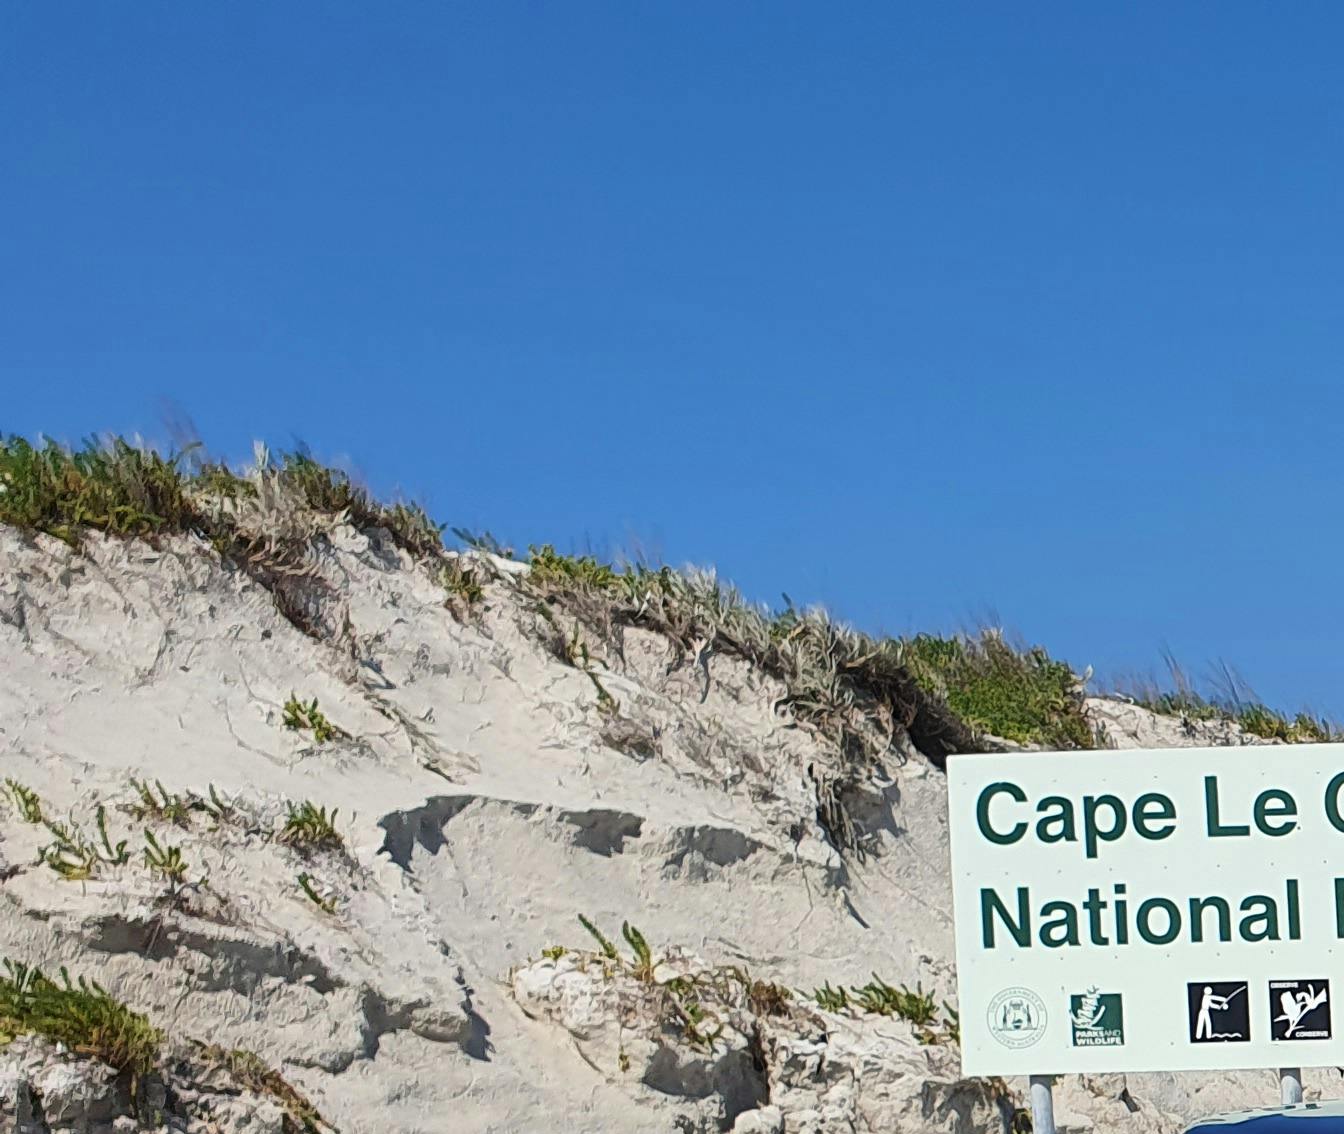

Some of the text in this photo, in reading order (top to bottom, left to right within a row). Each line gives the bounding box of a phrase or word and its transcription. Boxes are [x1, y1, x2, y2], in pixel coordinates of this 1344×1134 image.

[976, 781, 1177, 859] Cape
[1204, 775, 1298, 837] Le
[980, 879, 1301, 949] National
[1075, 1037, 1121, 1046] WILDLIFE
